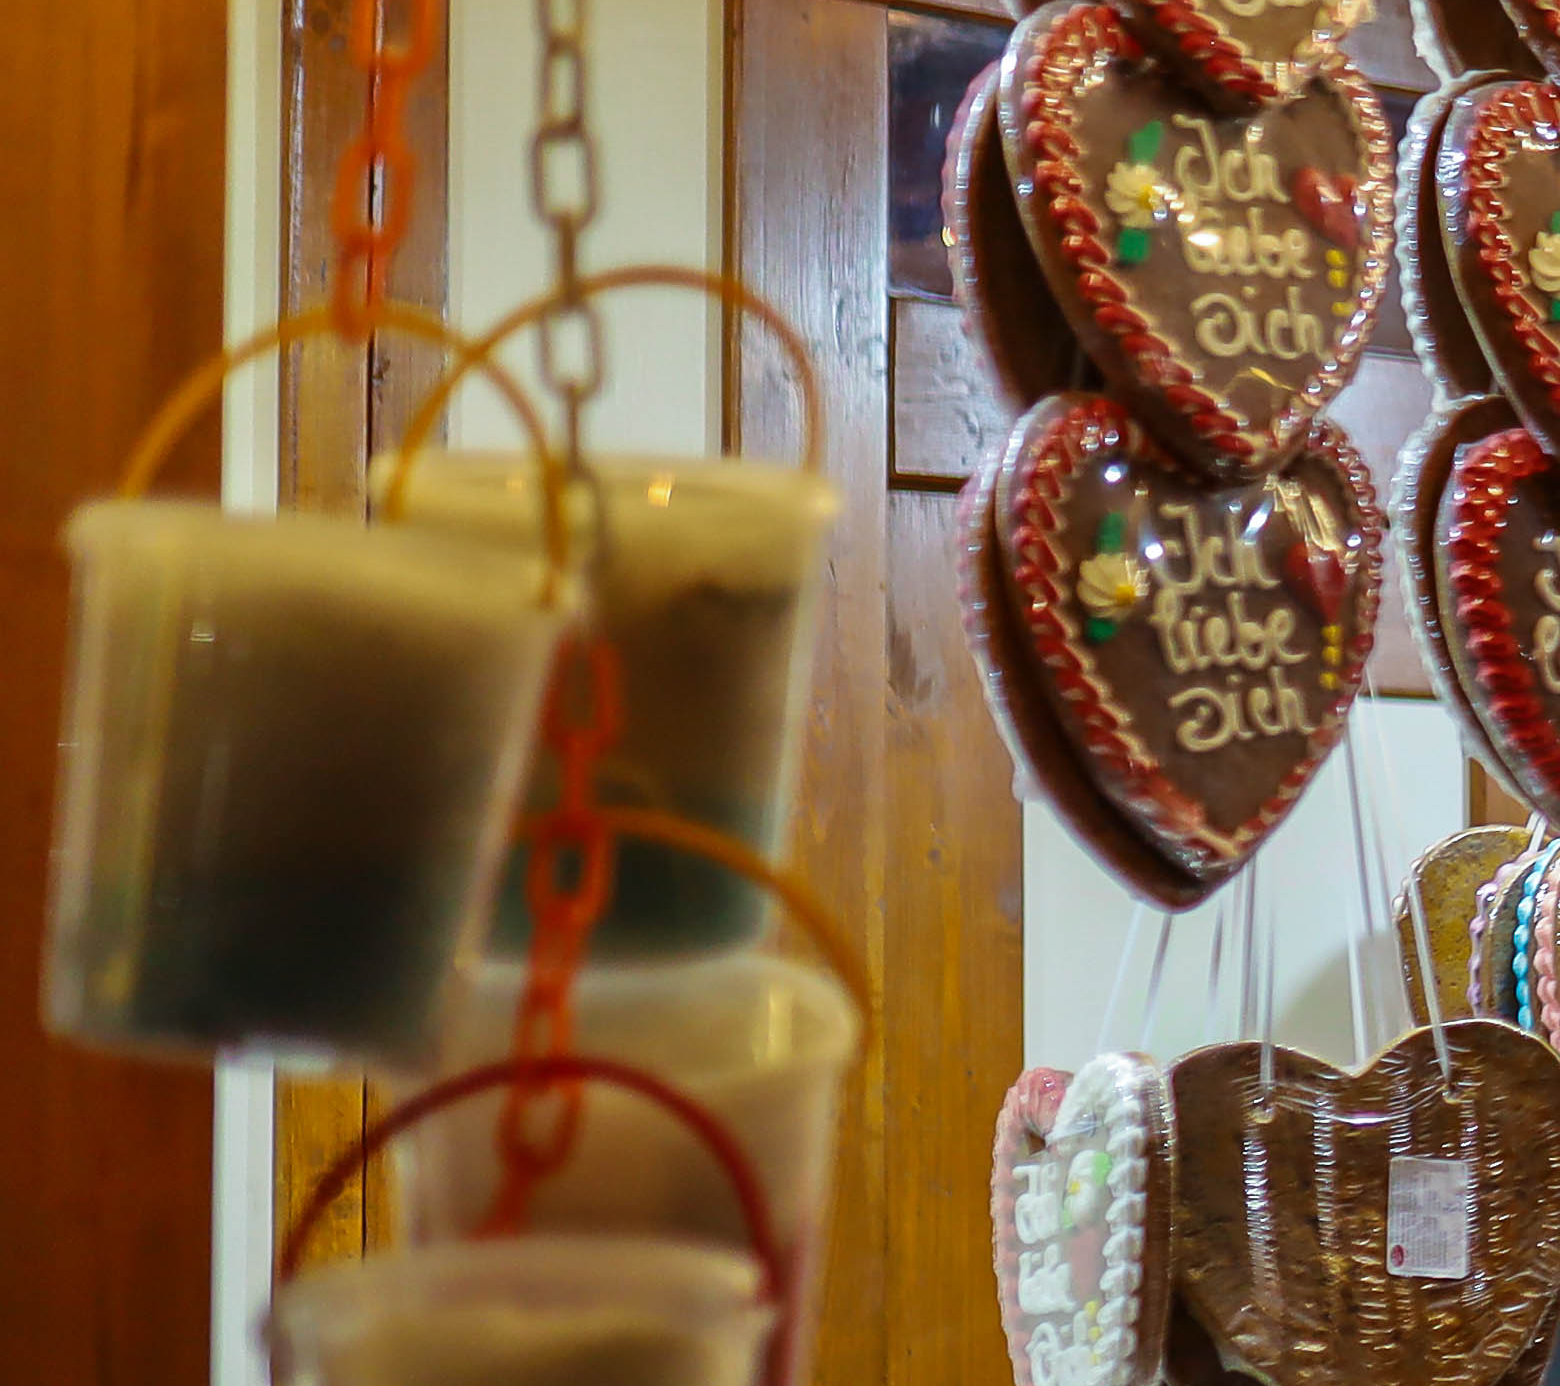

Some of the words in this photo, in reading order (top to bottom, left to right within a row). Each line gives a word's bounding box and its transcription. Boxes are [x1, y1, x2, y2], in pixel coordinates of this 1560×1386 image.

[1172, 113, 1290, 205] Ich
[1199, 288, 1326, 359] Dich
[1155, 501, 1280, 598] Ich
[1152, 587, 1308, 673] liebe
[1170, 668, 1320, 753] Dich
